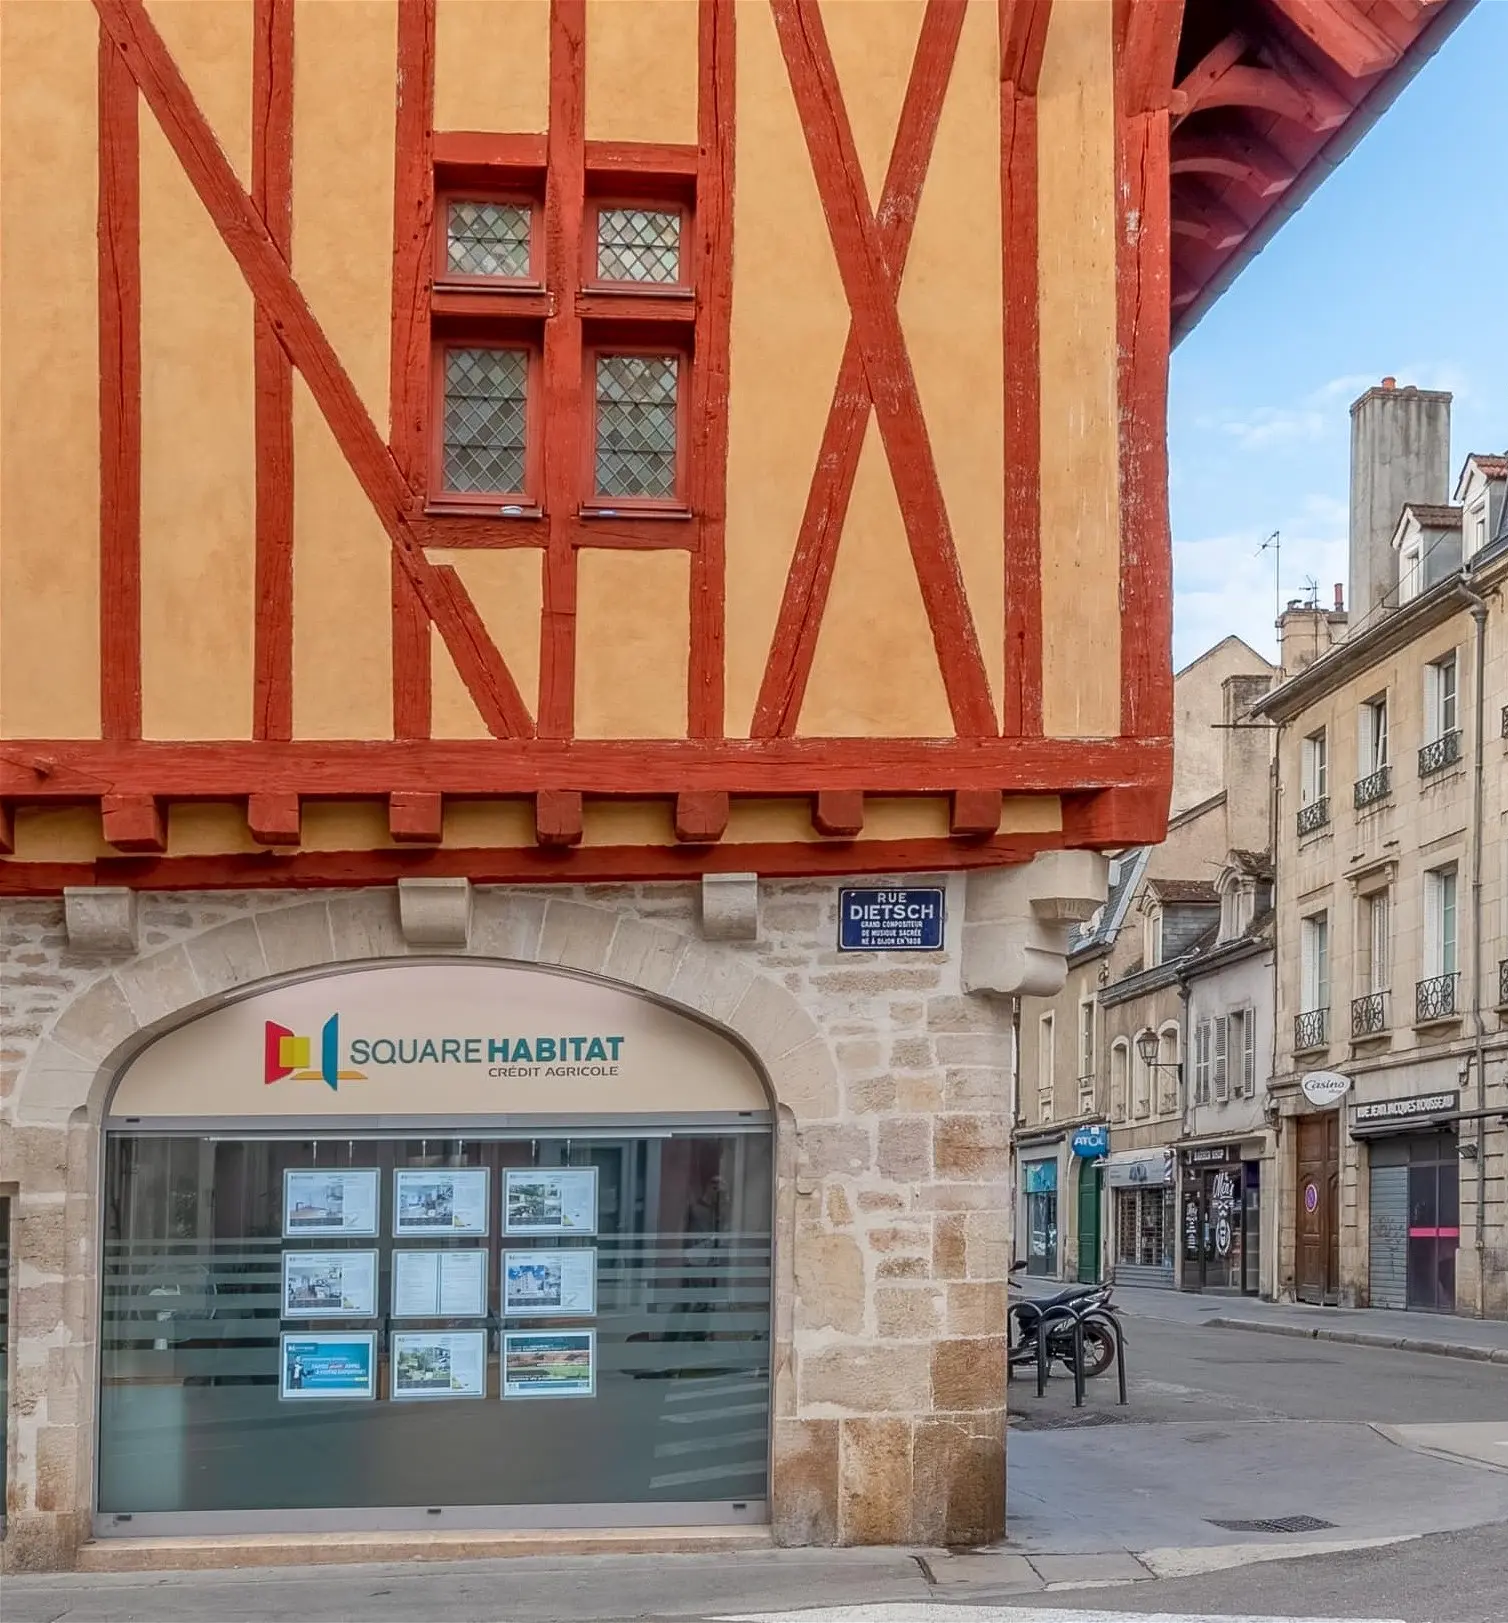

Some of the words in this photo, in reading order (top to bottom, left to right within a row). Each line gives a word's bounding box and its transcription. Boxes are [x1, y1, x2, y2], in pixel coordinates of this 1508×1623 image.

[877, 892, 907, 903] RUE
[850, 904, 934, 920] DIETSCH
[871, 929, 897, 937] MUSIQUE
[350, 1038, 482, 1065] SQUARE
[488, 1036, 625, 1062] HABITAT
[488, 1065, 542, 1078] CRÉDIT
[545, 1066, 619, 1077] AGRICOLE
[1304, 1079, 1345, 1091] Casino
[1357, 1105, 1371, 1118] RUE
[1371, 1103, 1387, 1116] JEAN
[1387, 1100, 1416, 1115] JACQUES
[1416, 1094, 1455, 1111] ROUSSEAU
[1074, 1136, 1104, 1147] ATOL
